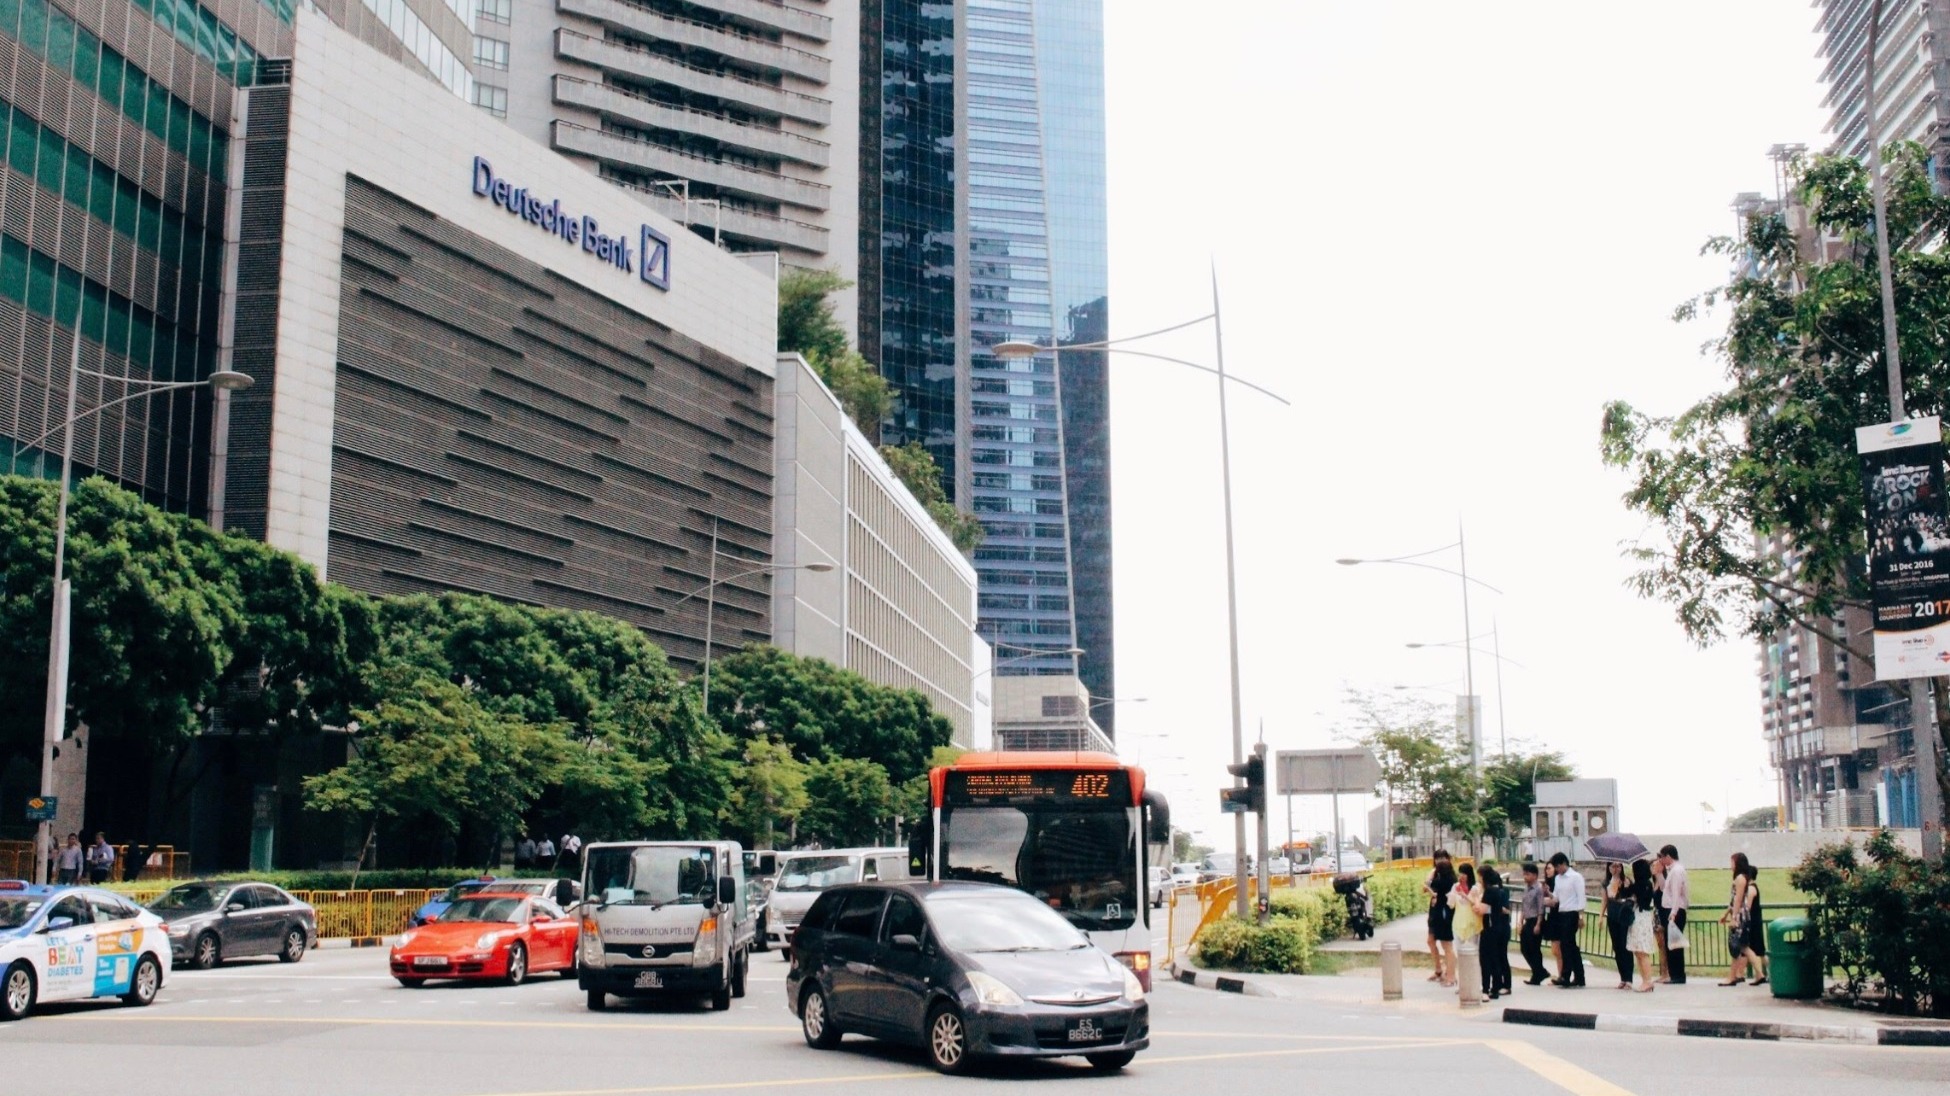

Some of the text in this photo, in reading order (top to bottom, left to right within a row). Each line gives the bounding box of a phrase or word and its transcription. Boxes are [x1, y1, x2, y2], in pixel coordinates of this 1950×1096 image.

[473, 156, 634, 273] Deutsche Bank
[1884, 471, 1930, 494] ROCK
[1887, 490, 1917, 511] ON
[1889, 560, 1934, 572] 31 Dec 2016
[1914, 600, 1950, 617] 2017
[1879, 613, 1912, 621] COUNTDOWN
[1071, 774, 1110, 797] 402
[604, 927, 695, 936] HI-TECH DEMOLITION PTE LTD
[48, 945, 84, 966] BEAT
[48, 966, 84, 977] DIABETES
[1080, 1019, 1093, 1030] ES
[1069, 1028, 1102, 1040] 8662C
